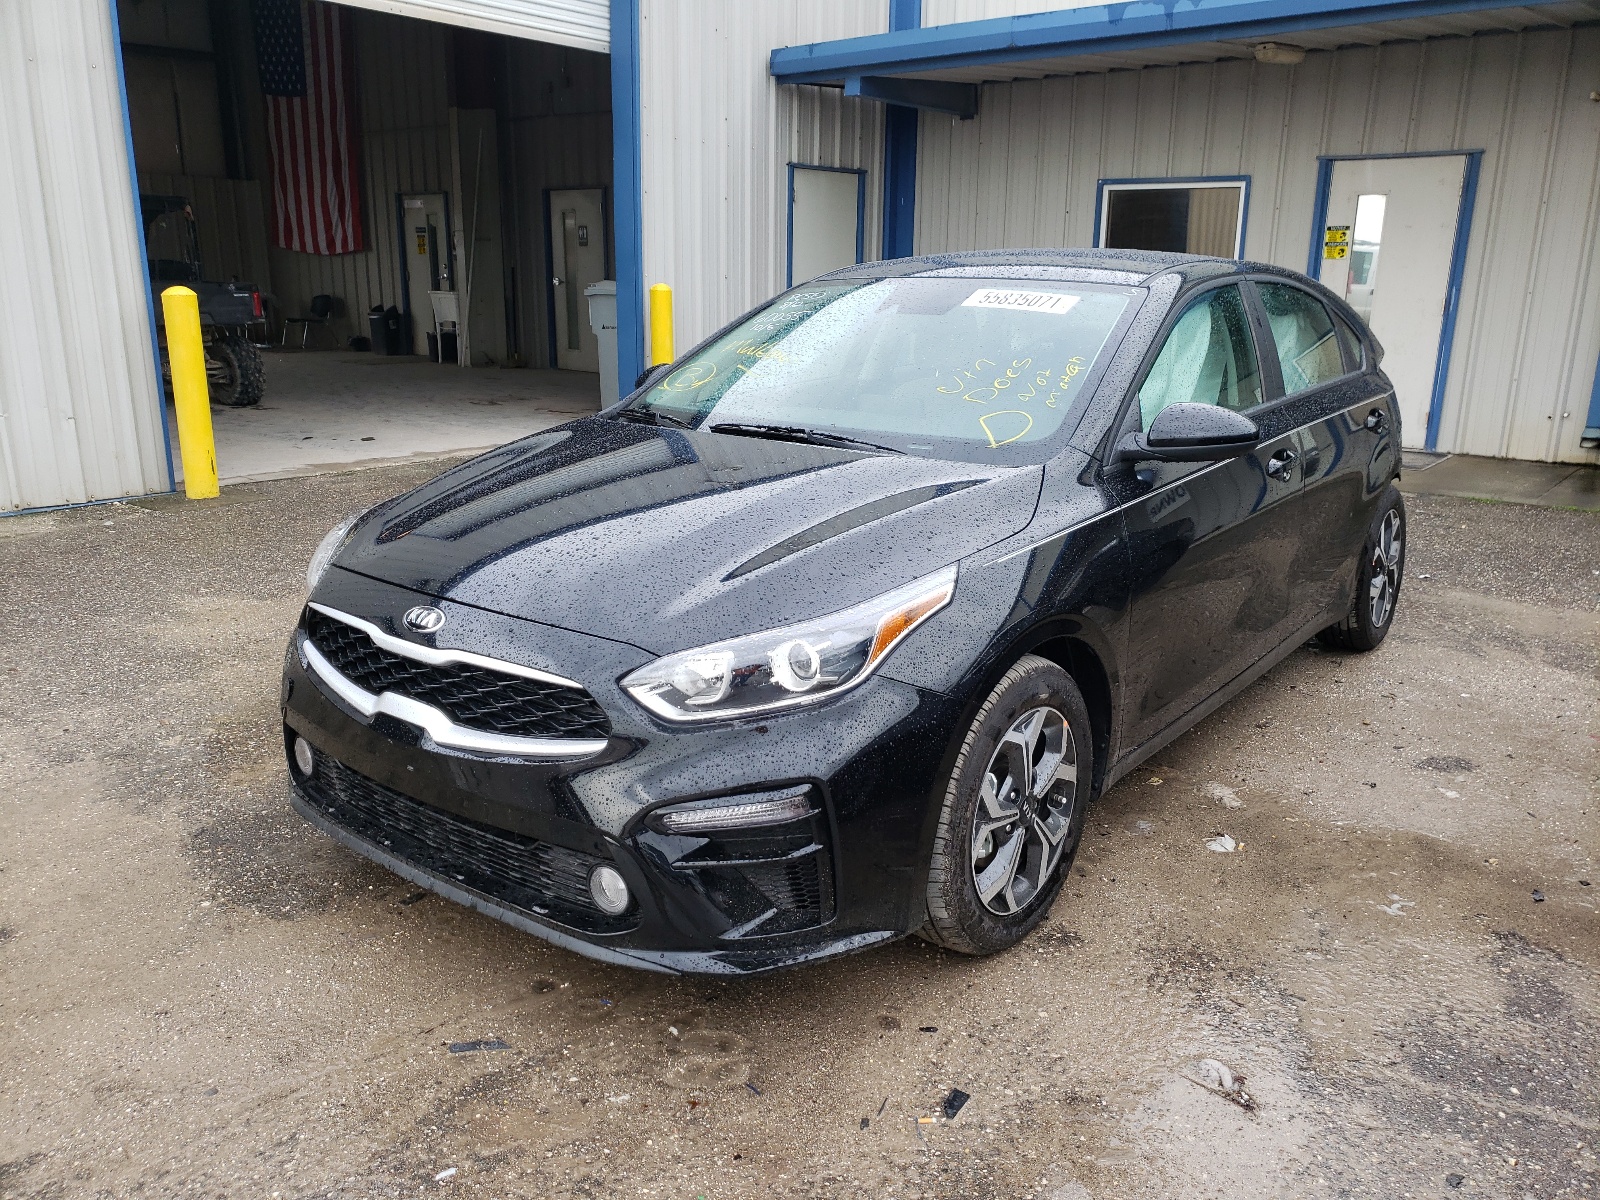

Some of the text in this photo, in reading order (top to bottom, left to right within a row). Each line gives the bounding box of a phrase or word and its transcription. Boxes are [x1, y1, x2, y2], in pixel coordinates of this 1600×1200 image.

[979, 291, 1062, 309] 55835071
[962, 358, 1032, 405] Does
[1016, 368, 1051, 402] Not
[978, 410, 1033, 448] D
[406, 608, 438, 628] KIA
